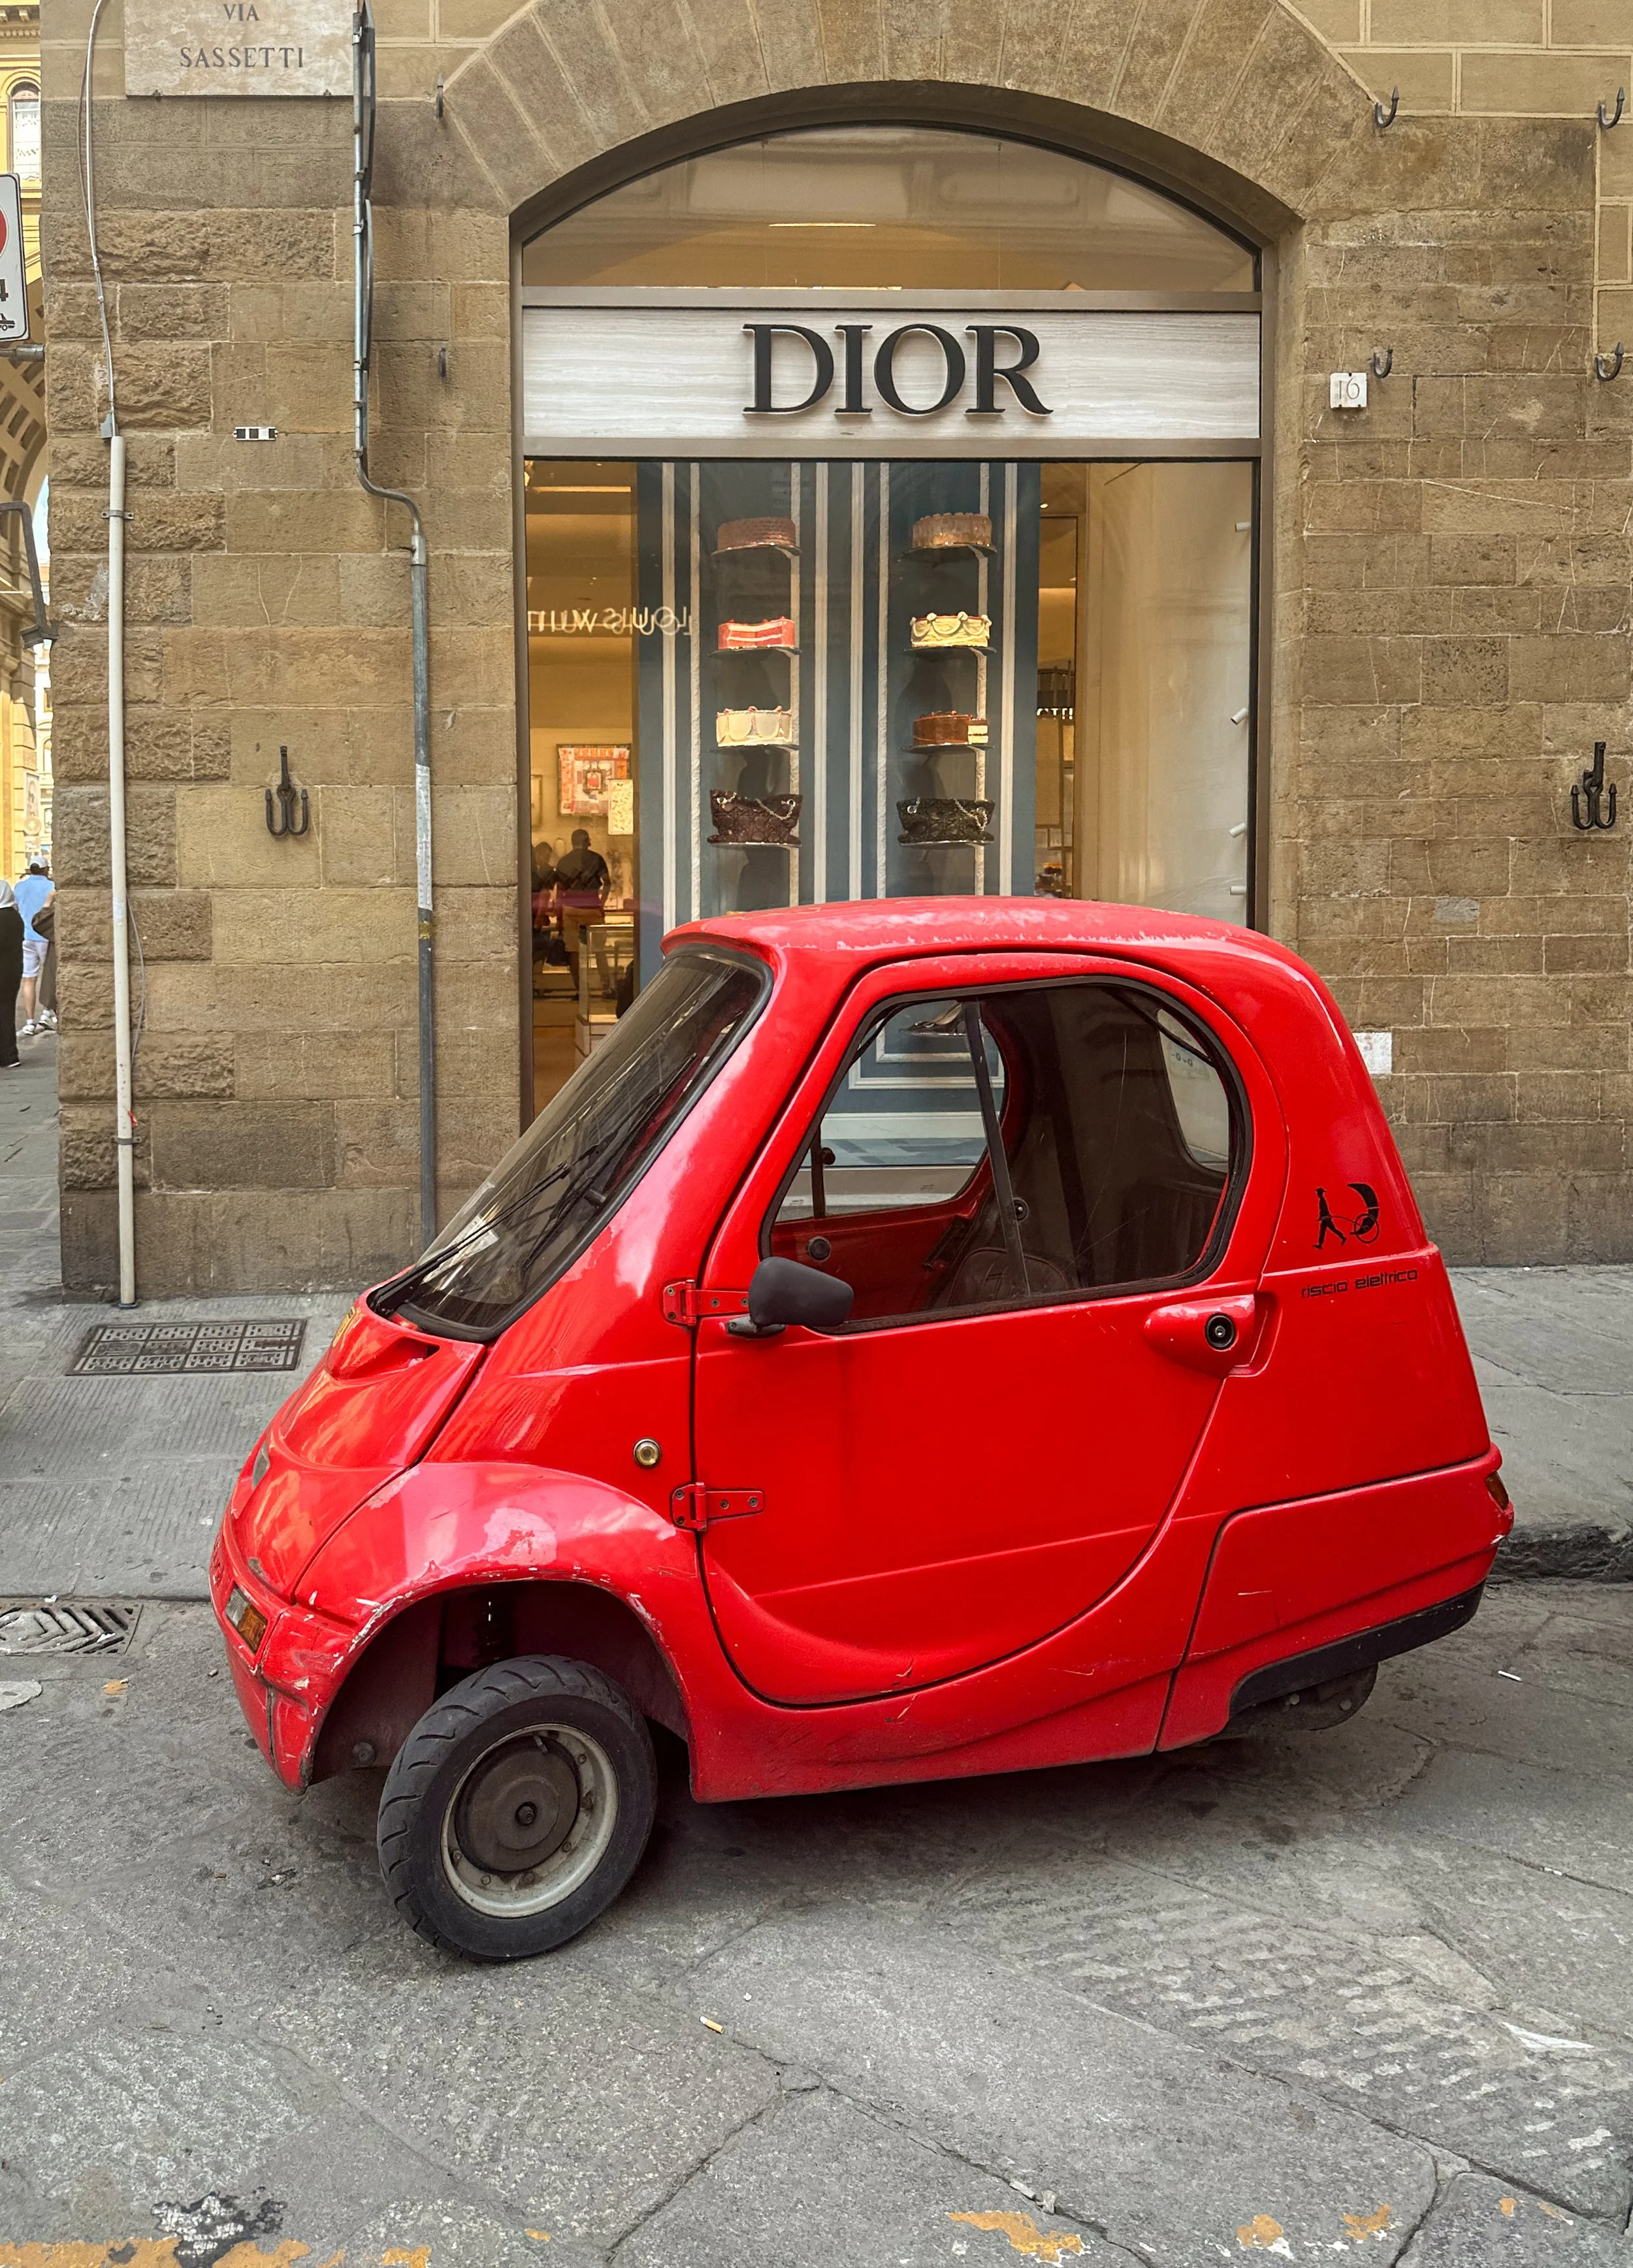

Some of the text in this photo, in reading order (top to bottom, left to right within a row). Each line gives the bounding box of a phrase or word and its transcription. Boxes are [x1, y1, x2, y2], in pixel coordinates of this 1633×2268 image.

[223, 4, 260, 21] VIA
[180, 47, 304, 68] SASSETTI
[742, 323, 1054, 417] DIOR
[1339, 378, 1360, 400] 16
[1355, 1269, 1419, 1290] elettrico
